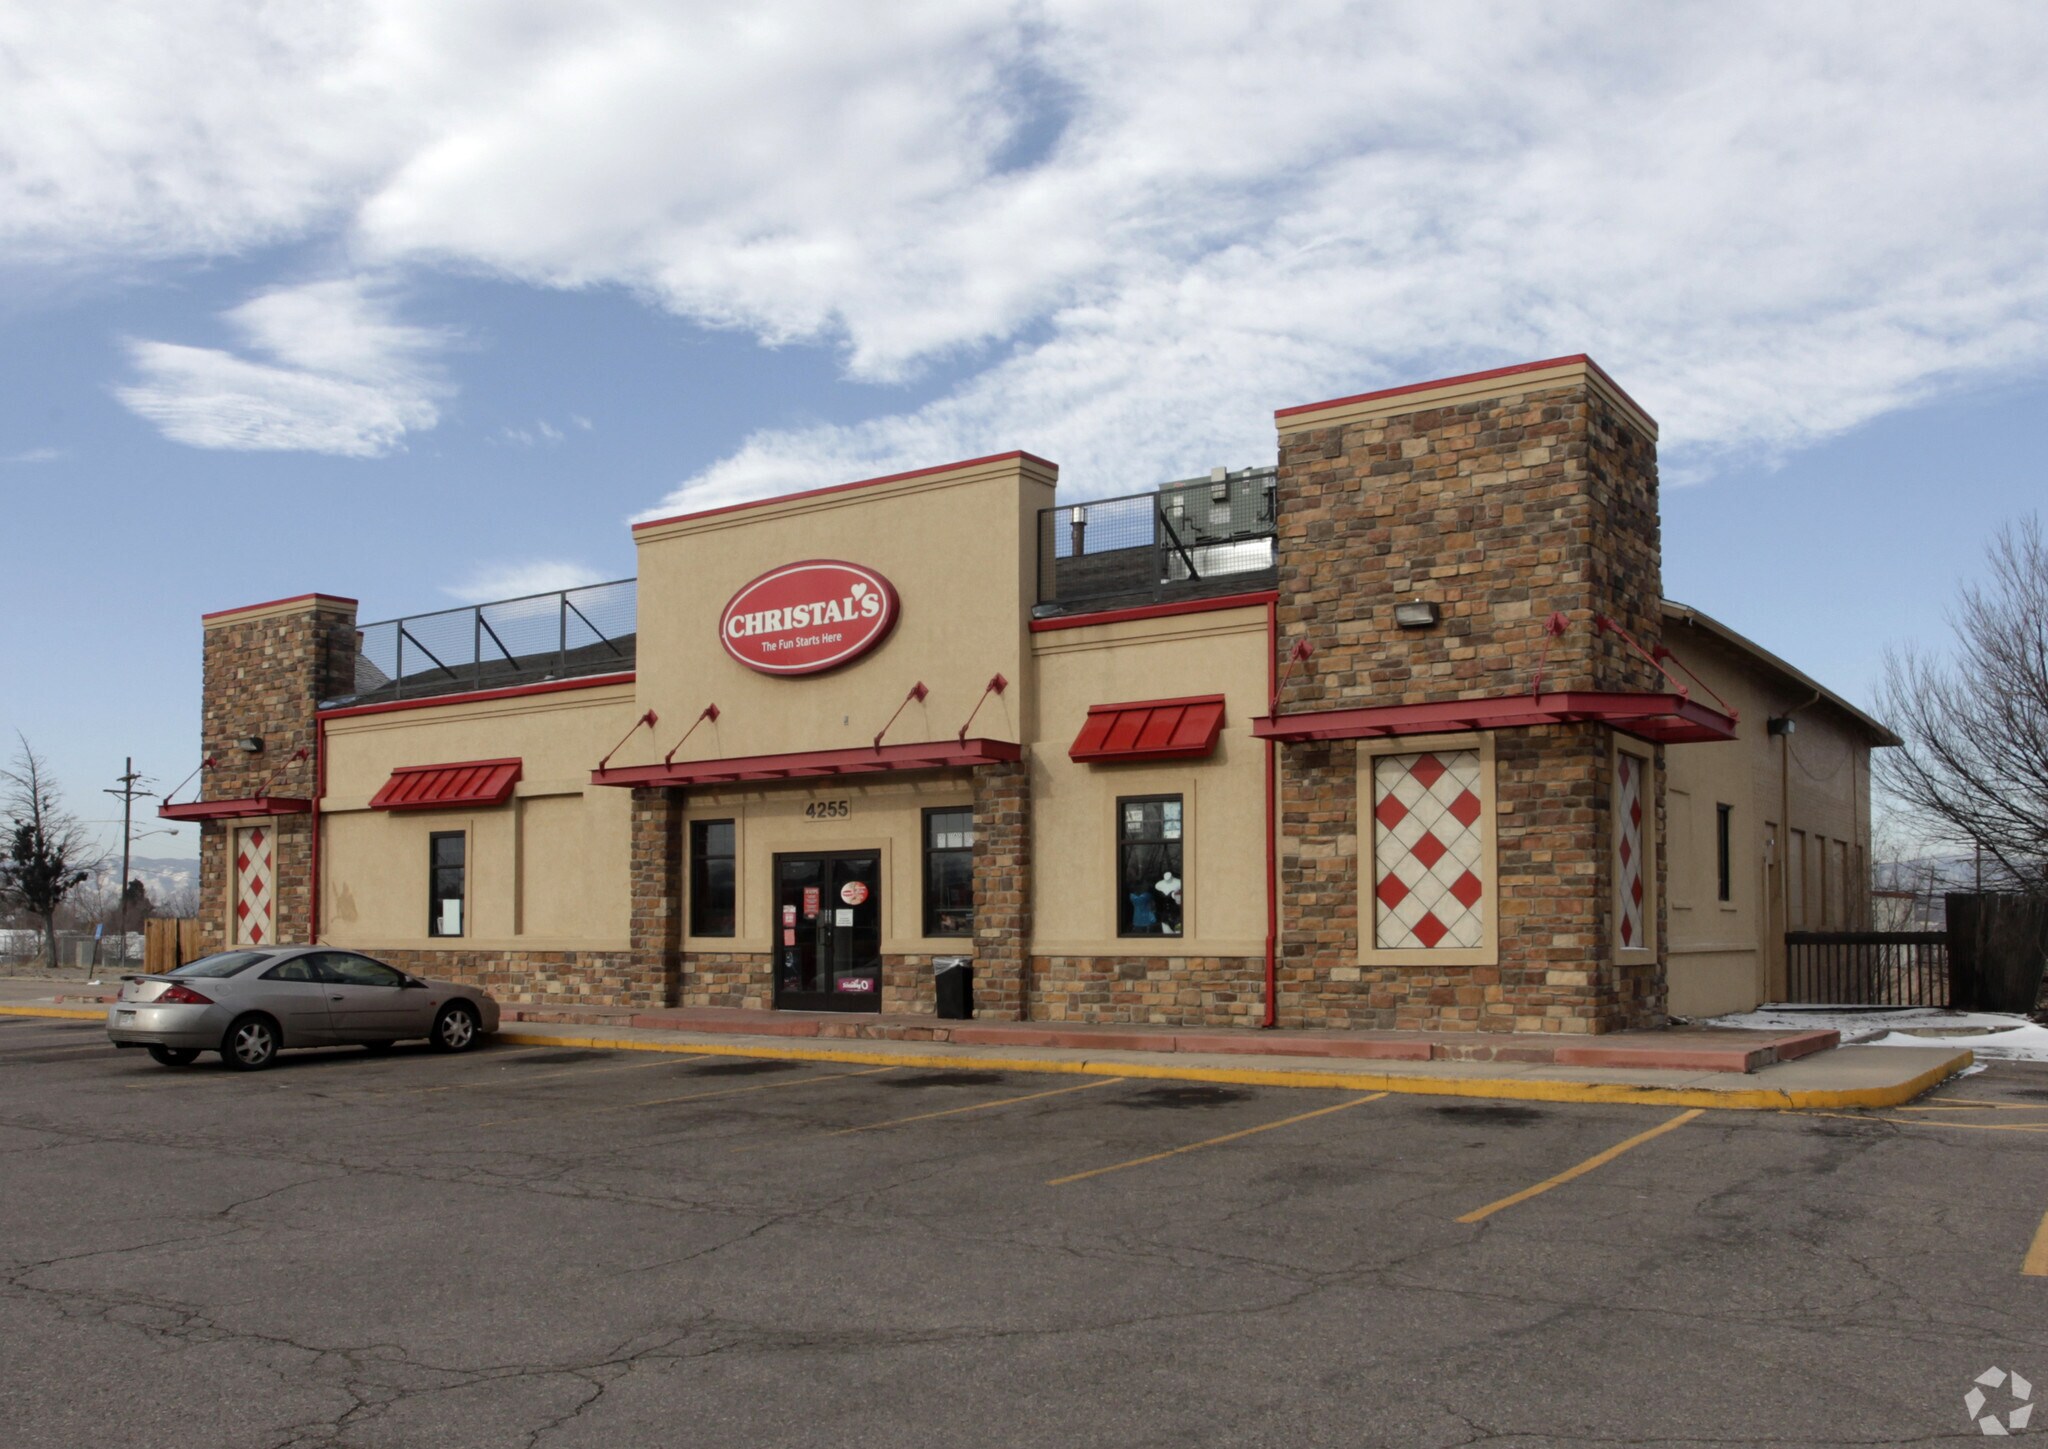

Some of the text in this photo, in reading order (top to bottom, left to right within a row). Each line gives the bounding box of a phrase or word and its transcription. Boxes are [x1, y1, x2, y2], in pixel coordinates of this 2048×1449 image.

[728, 583, 879, 638] CHRISTAL'S
[762, 632, 843, 652] The Fun Starts Here
[805, 800, 848, 819] 4255
